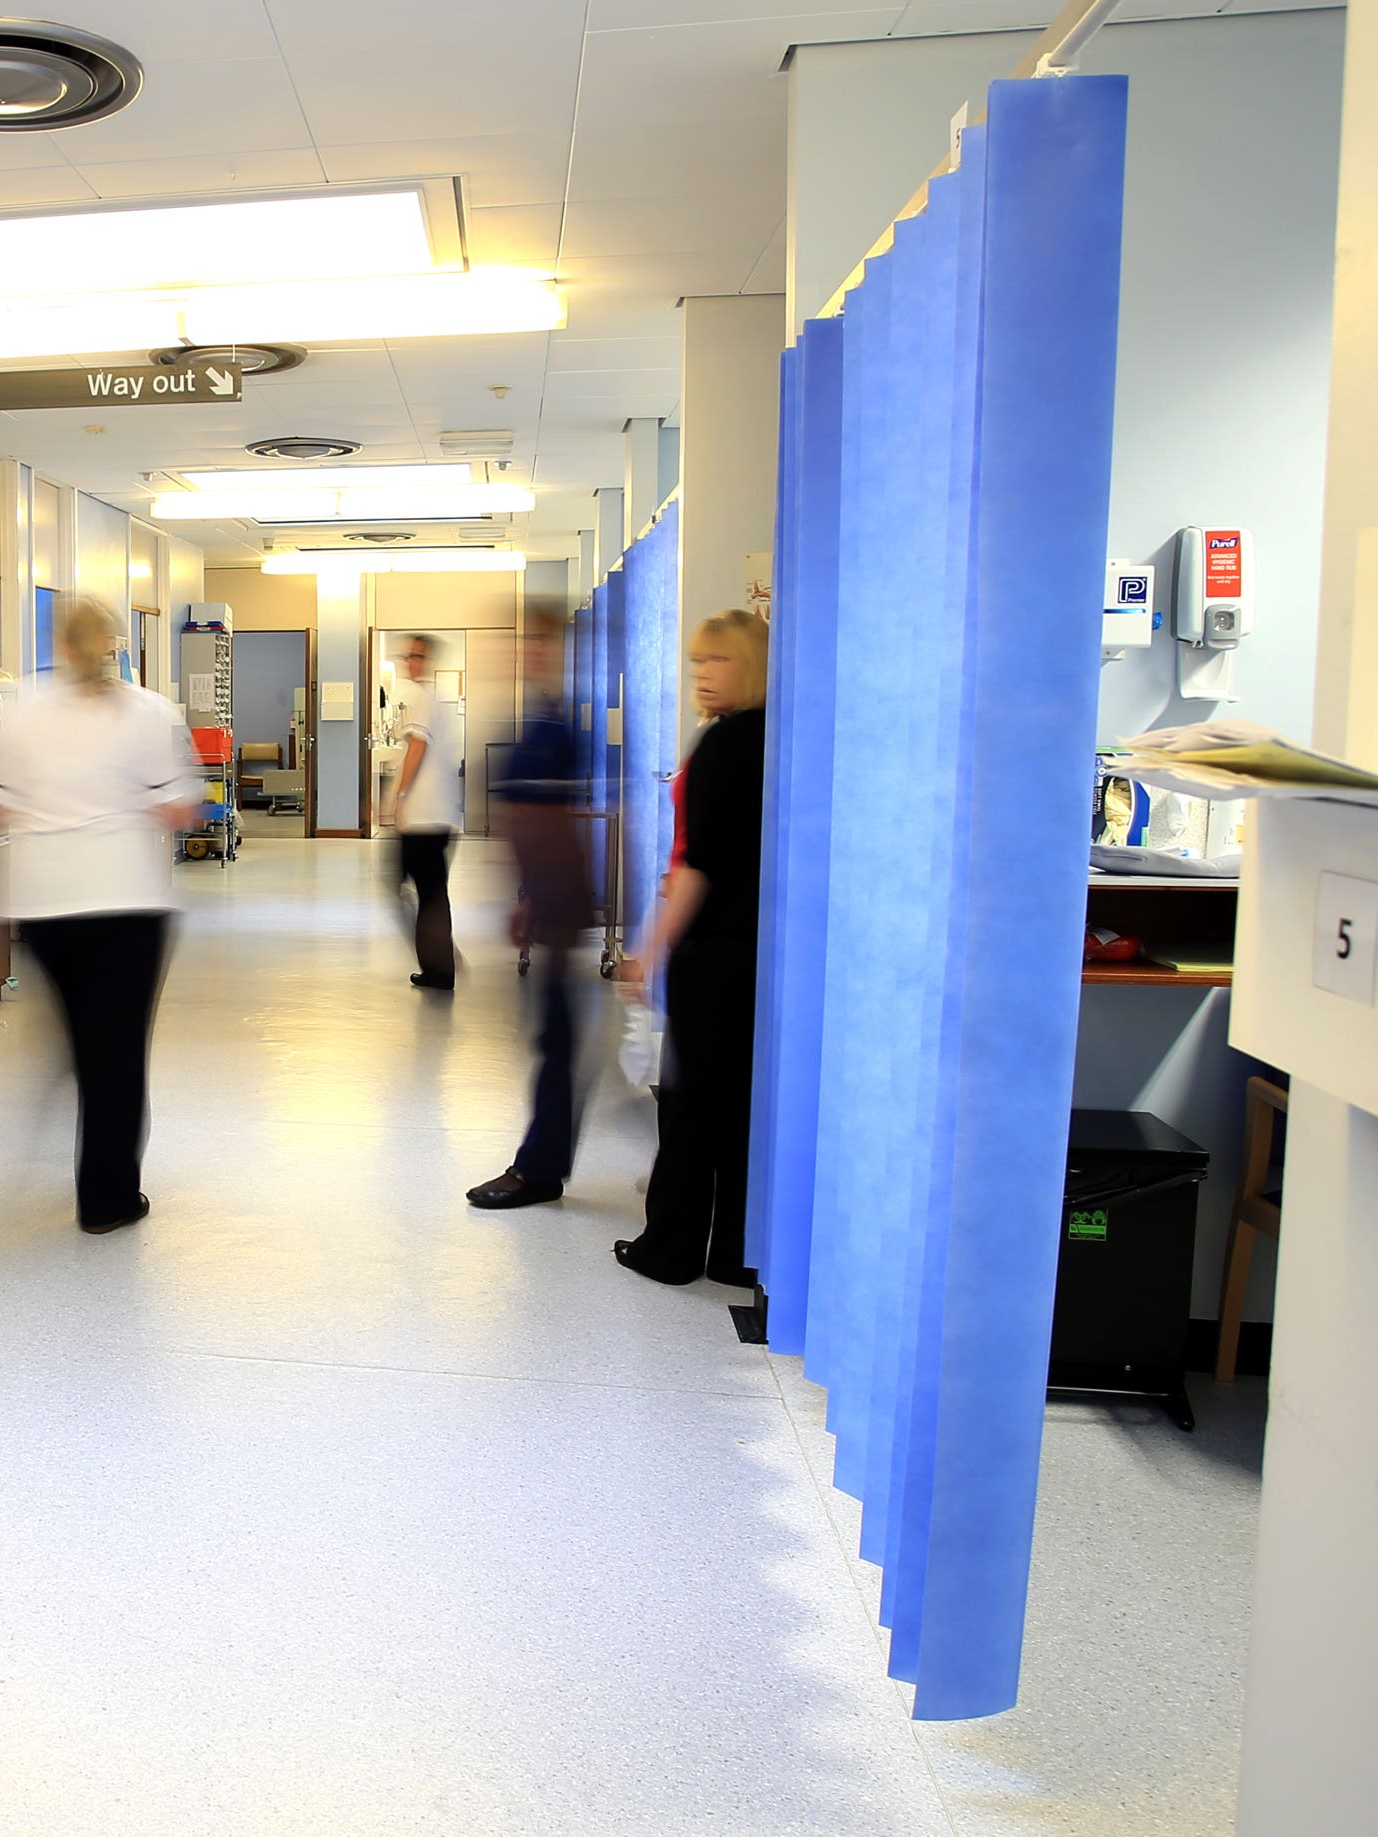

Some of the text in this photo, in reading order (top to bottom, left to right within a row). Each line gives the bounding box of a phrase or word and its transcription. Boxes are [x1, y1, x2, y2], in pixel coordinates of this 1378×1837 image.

[87, 369, 196, 399] Way out
[1211, 539, 1237, 548] Purell
[1337, 918, 1352, 960] 5
